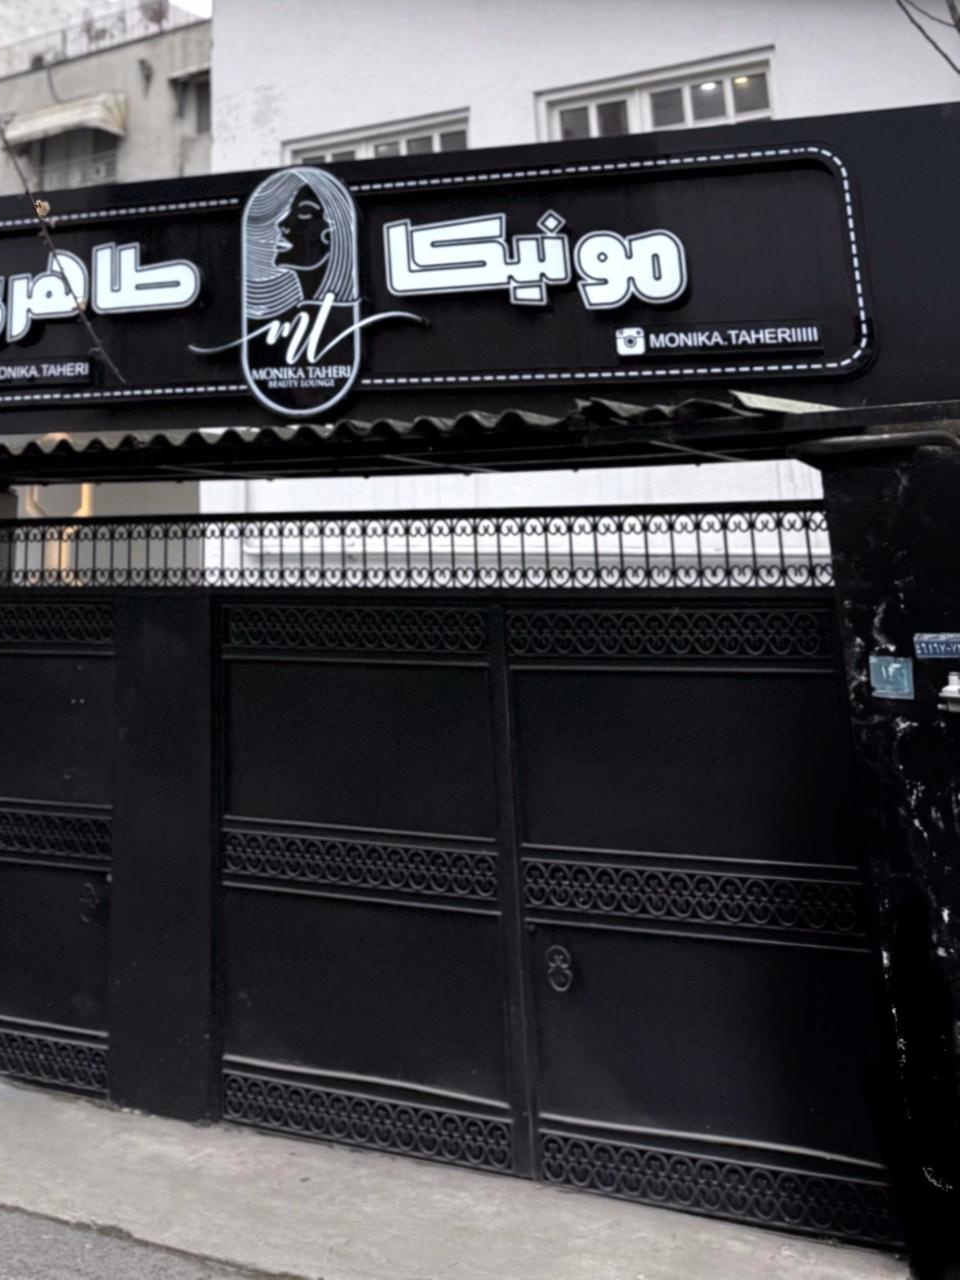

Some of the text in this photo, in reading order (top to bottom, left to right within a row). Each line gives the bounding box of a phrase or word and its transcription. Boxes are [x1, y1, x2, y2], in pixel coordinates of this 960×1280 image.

[383, 209, 688, 310] مونیکا
[649, 327, 818, 348] MONIKA.TAHERIIIII
[251, 365, 352, 381] MONIKA TAHERI
[268, 379, 335, 389] BEAUTY LOUNGE
